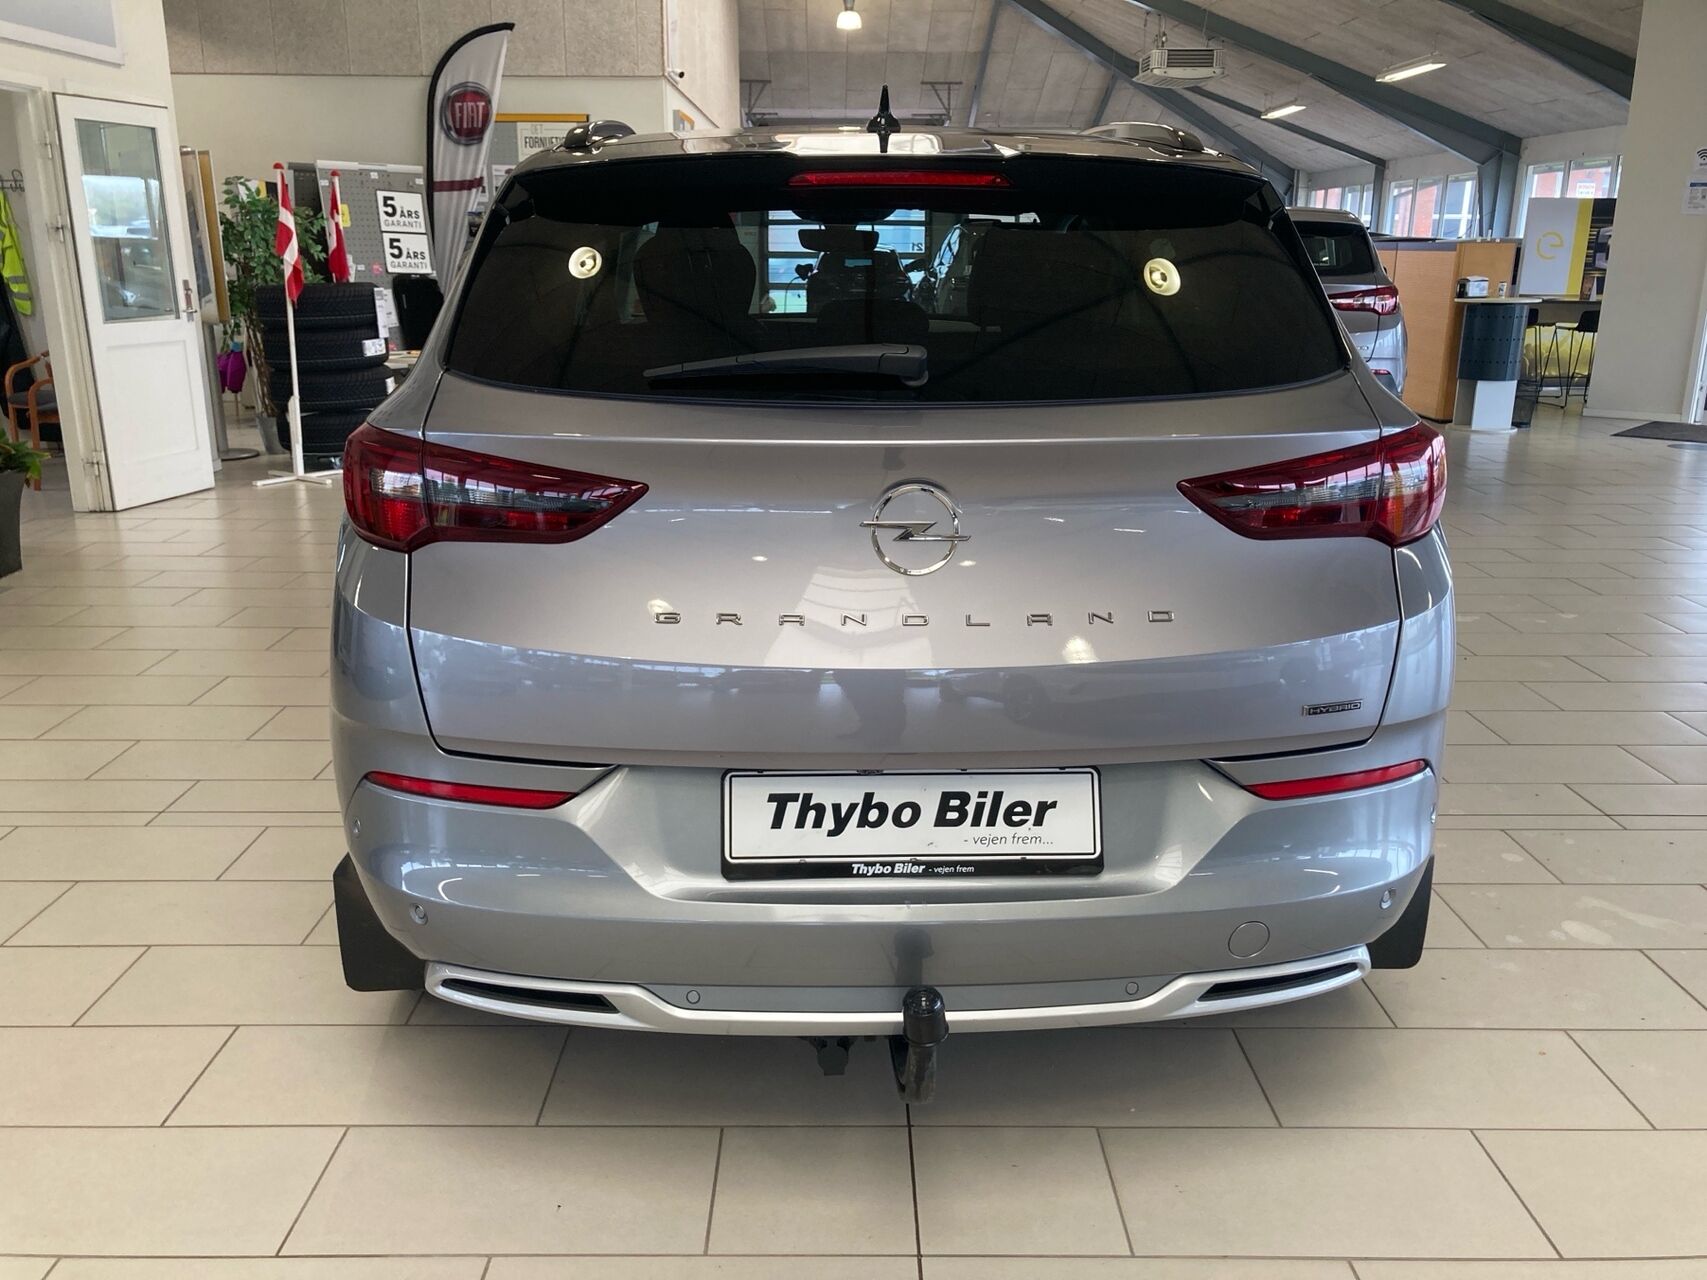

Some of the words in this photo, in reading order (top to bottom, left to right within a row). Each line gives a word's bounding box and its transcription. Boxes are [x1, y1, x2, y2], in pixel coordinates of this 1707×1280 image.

[454, 102, 486, 128] FIAT
[383, 196, 397, 218] 5
[400, 206, 420, 219] ÅRS
[384, 219, 422, 229] GARANTI
[389, 238, 403, 260] 5
[406, 248, 426, 260] ÅRS
[390, 261, 428, 270] GARANTI
[654, 609, 1175, 627] GRANDLAND
[1309, 702, 1361, 715] HYBRID
[766, 792, 922, 837] Thybo
[933, 790, 1058, 828] Biler
[972, 833, 1008, 847] vejen
[1011, 832, 1054, 845] frem...
[851, 863, 892, 876] Thybo
[893, 862, 926, 874] Biler
[933, 865, 955, 874] vejen
[956, 864, 975, 873] frem
